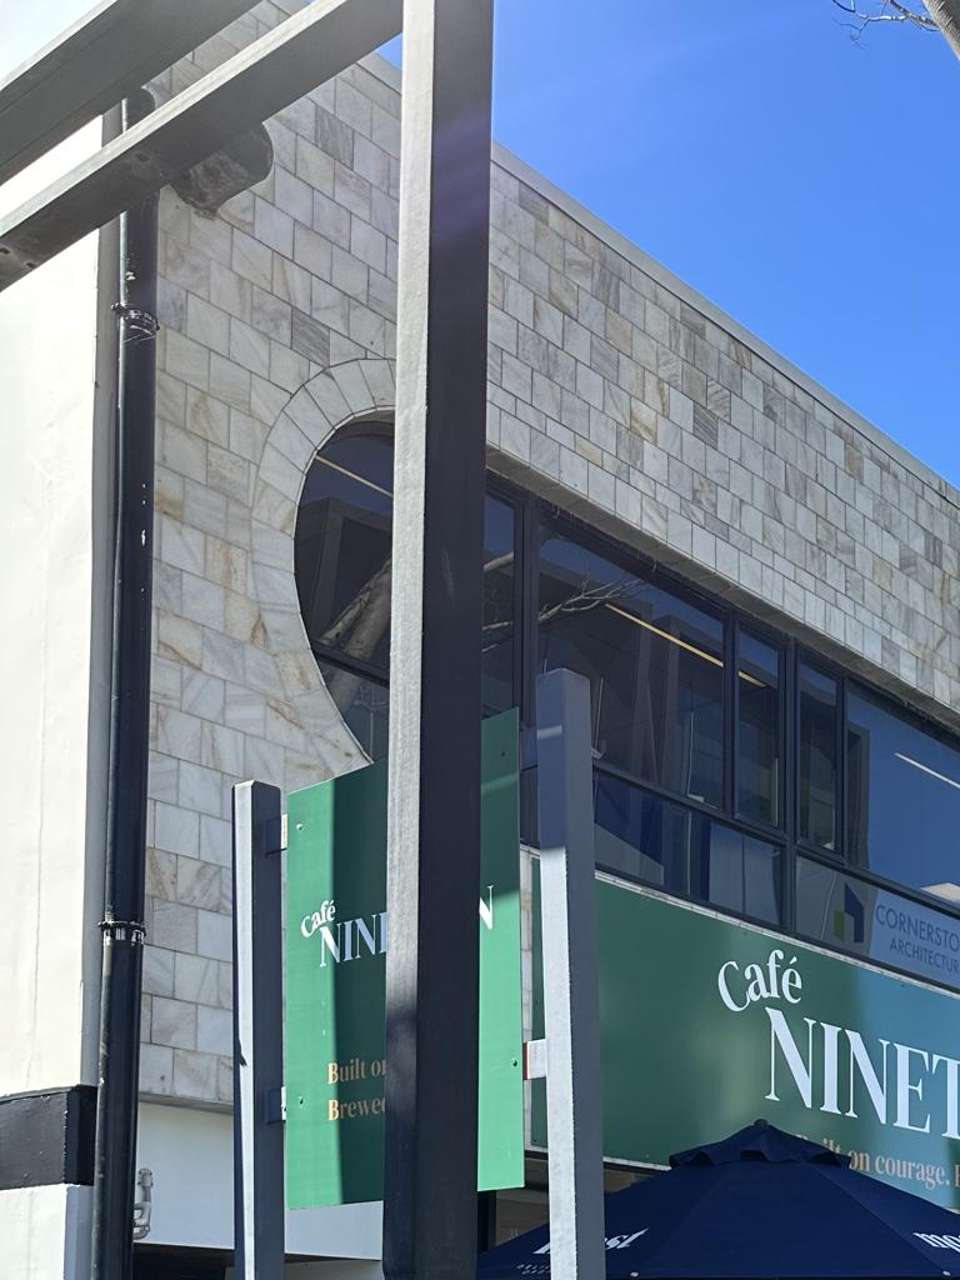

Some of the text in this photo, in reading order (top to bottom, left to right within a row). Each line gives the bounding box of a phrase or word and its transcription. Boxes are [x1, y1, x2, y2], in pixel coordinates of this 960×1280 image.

[300, 899, 336, 939] Café
[717, 949, 802, 1012] Café
[328, 1057, 367, 1085] Built
[328, 1096, 386, 1121] Brewe
[875, 1154, 950, 1190] courage.
